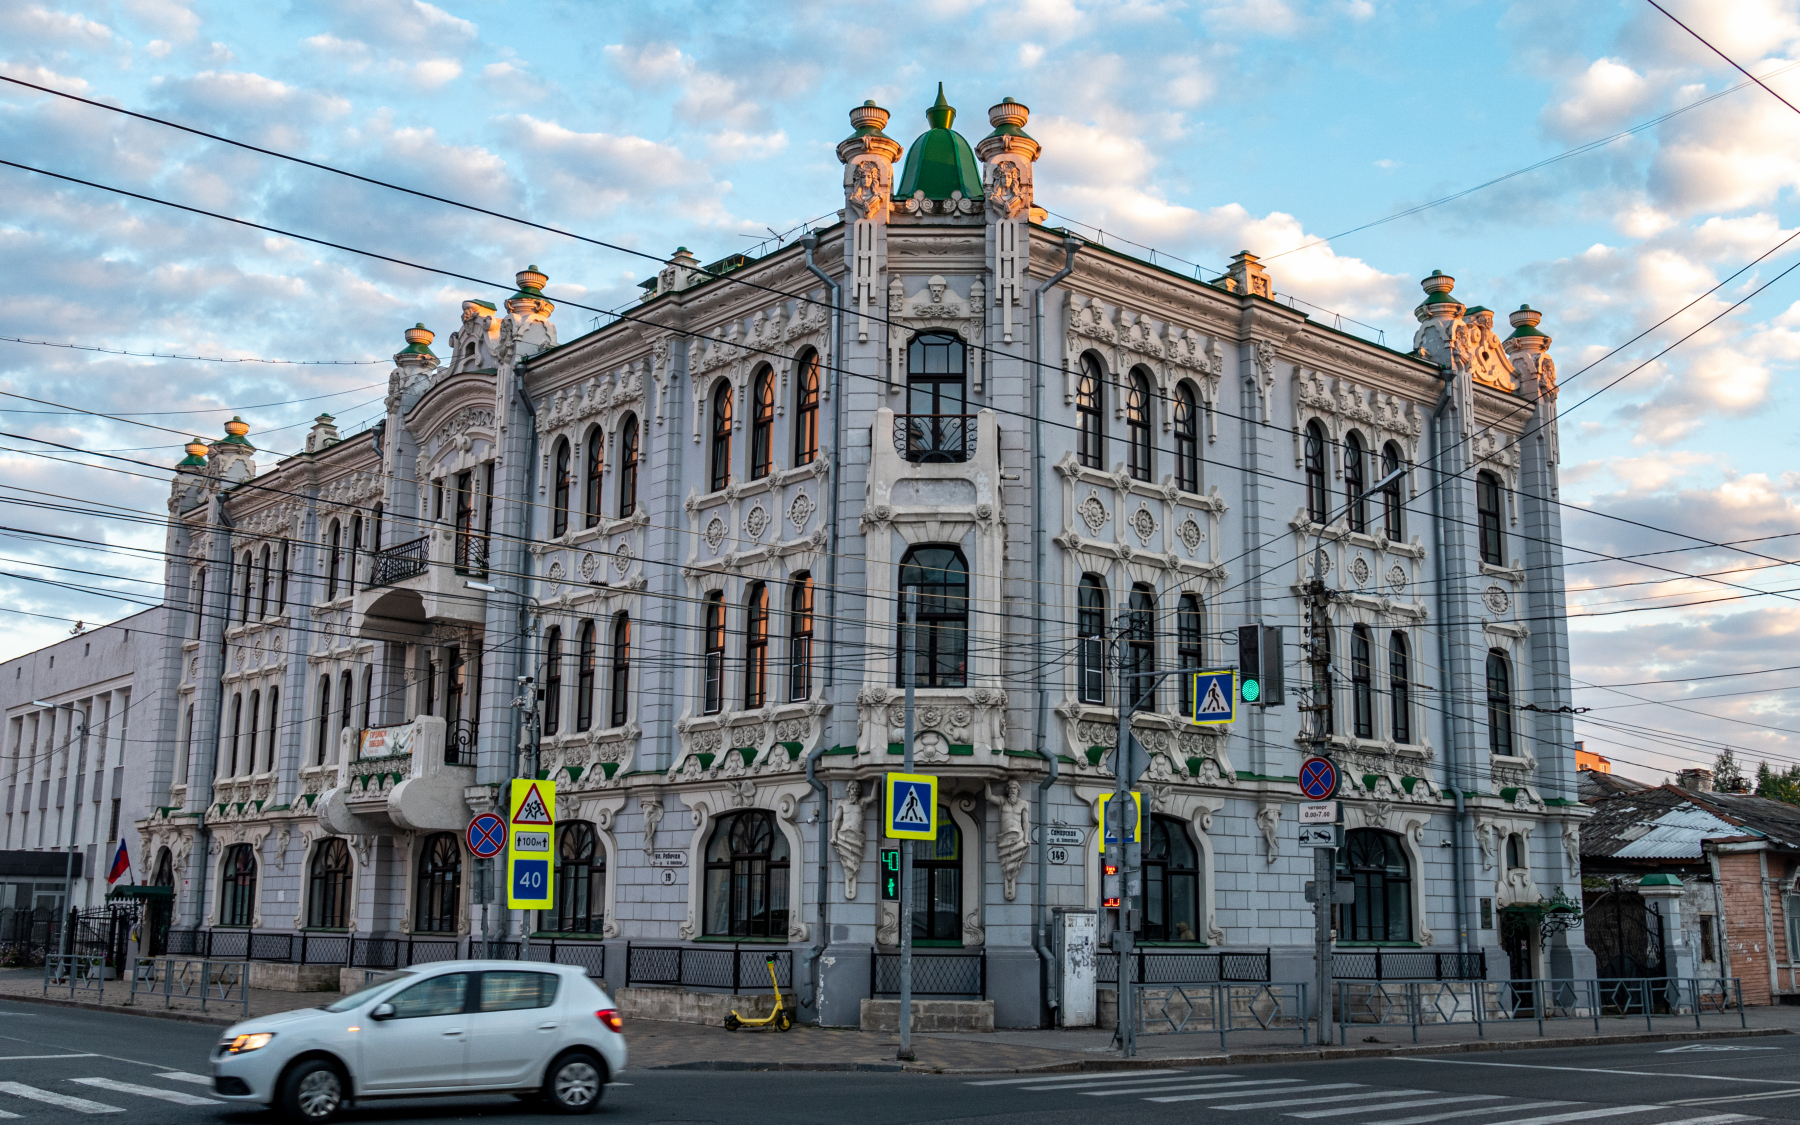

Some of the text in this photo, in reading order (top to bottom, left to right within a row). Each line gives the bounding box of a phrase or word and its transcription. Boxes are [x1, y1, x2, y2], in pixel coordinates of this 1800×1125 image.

[1051, 829, 1076, 837] Самарская
[523, 837, 542, 847] 100м
[1051, 851, 1065, 860] 149
[882, 851, 899, 871] 40
[519, 871, 541, 888] 40
[665, 873, 671, 881] 19
